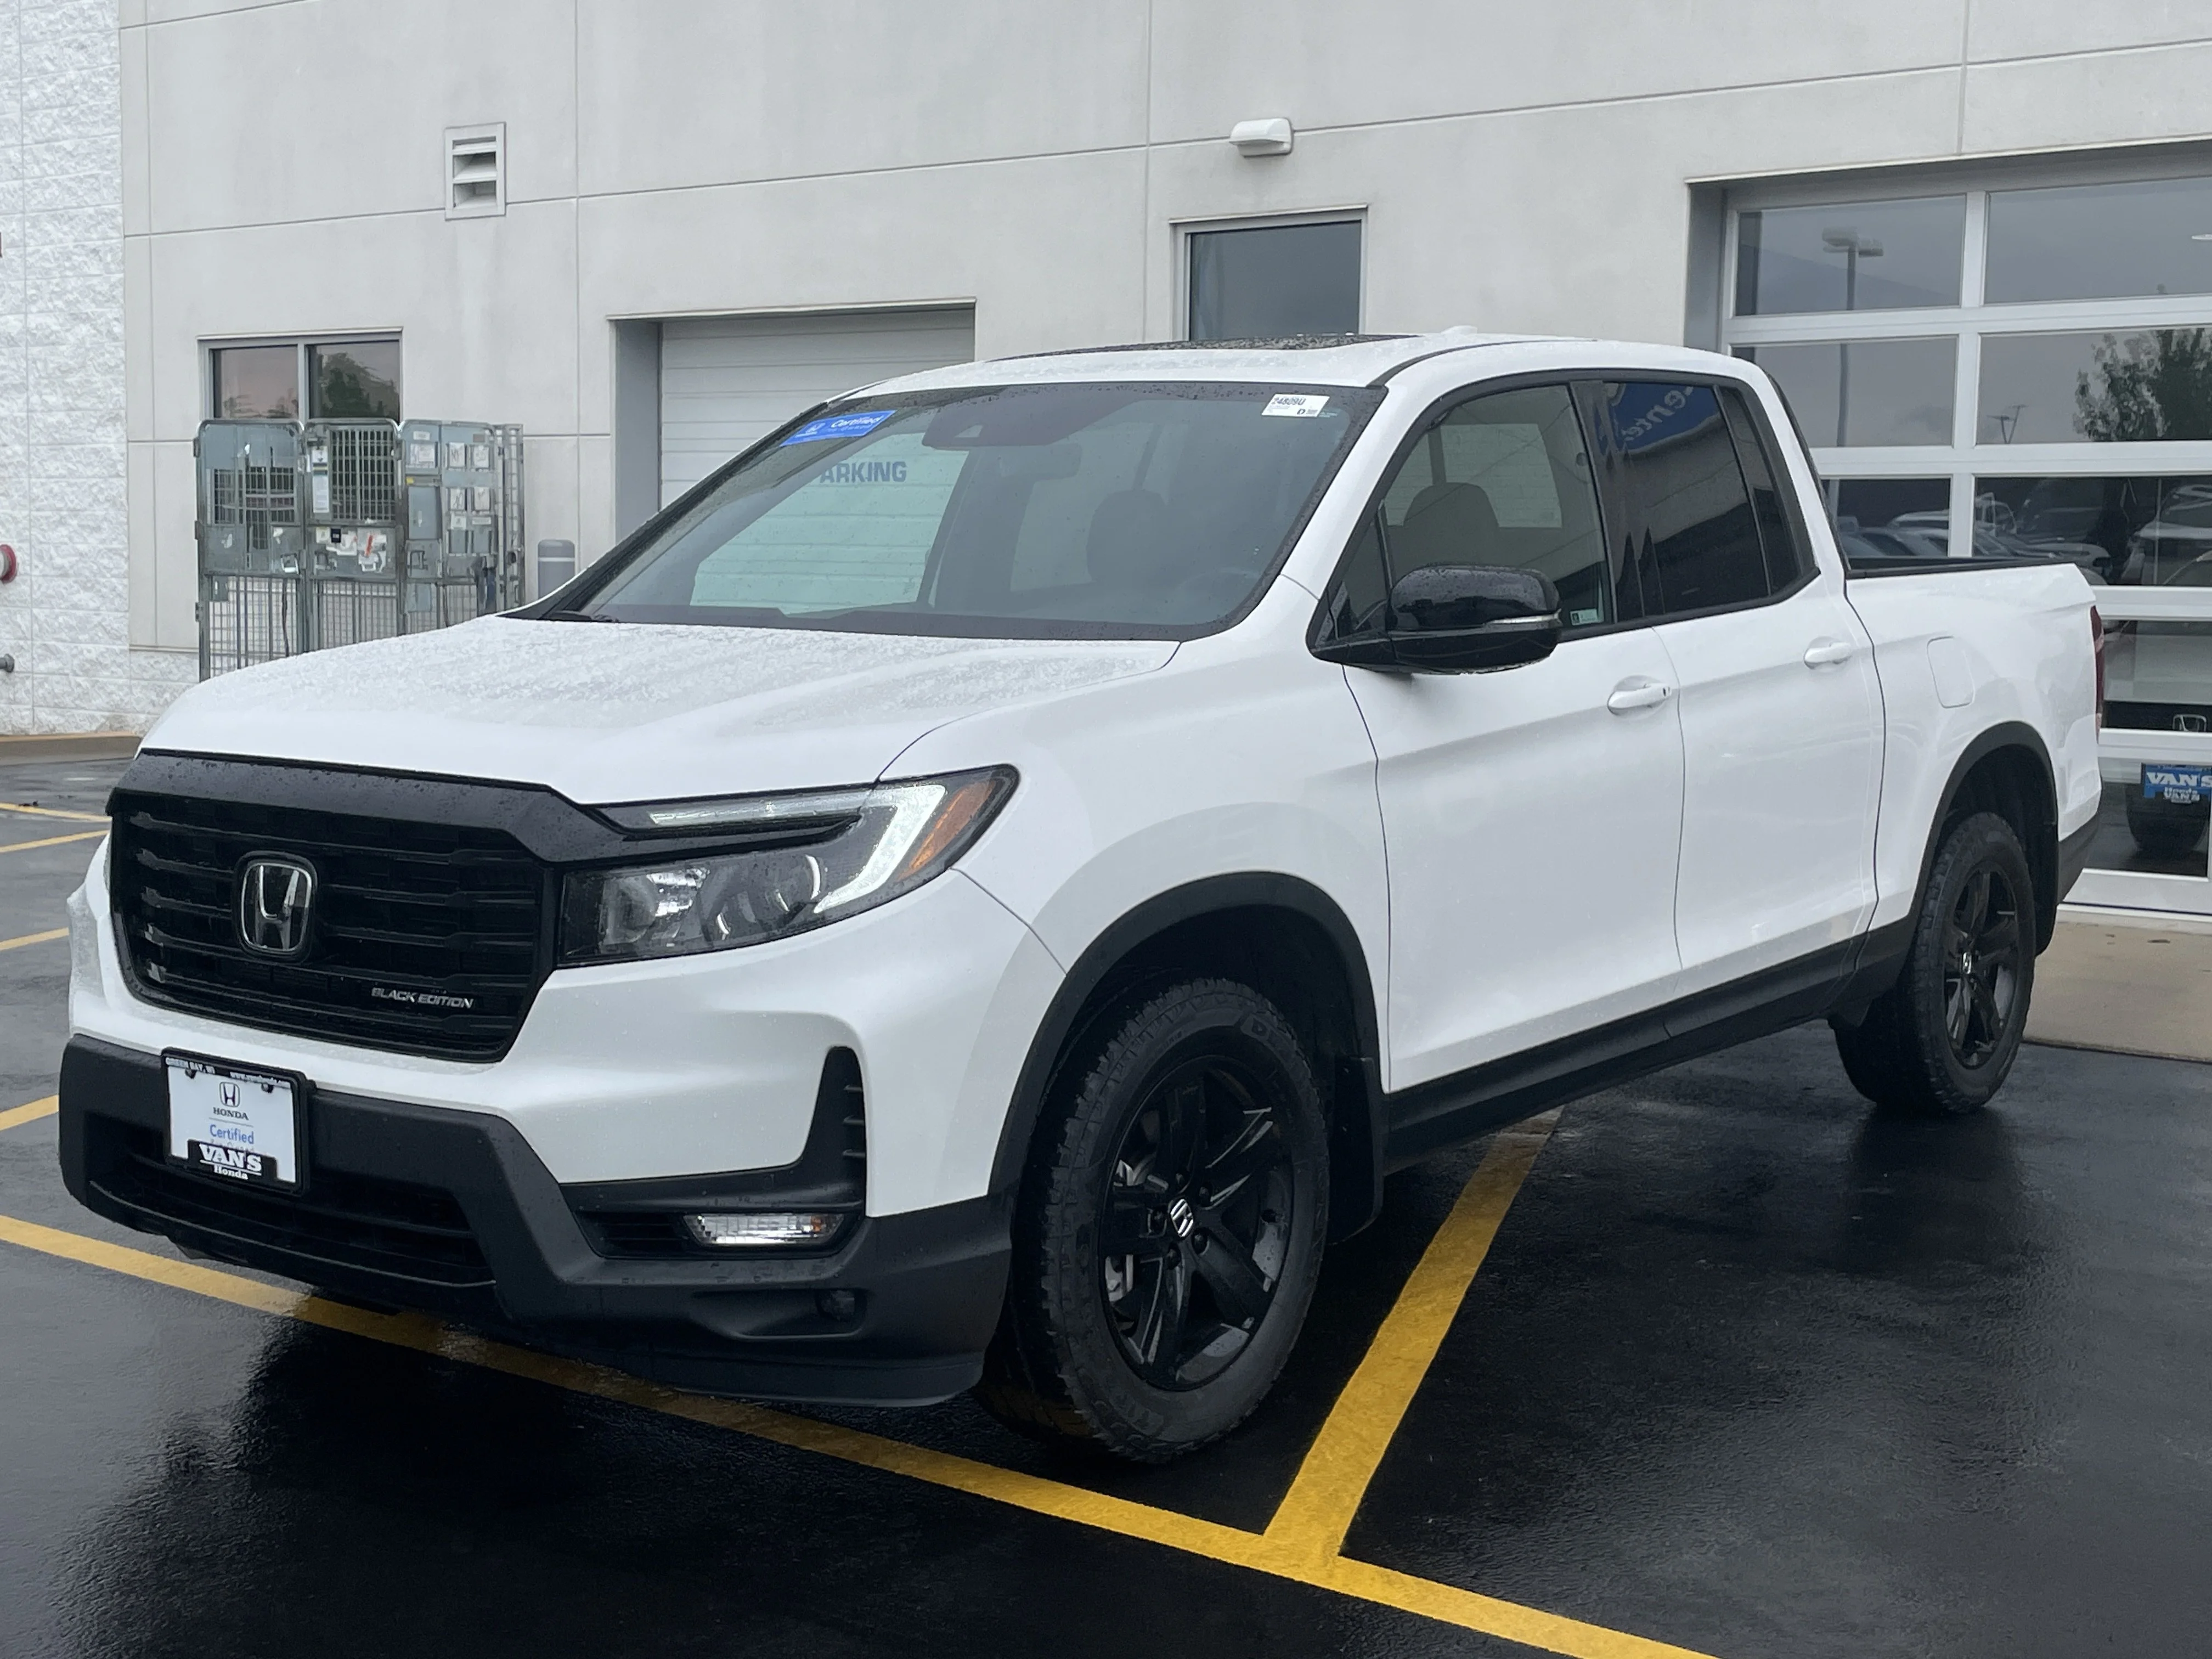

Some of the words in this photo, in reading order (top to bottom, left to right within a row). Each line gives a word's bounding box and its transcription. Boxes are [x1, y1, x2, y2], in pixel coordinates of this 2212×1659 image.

[820, 461, 906, 483] ARKING
[371, 987, 418, 1003] BLACK
[417, 992, 474, 1009] EDITION
[212, 1107, 249, 1120] HONDA
[210, 1124, 255, 1144] Certified
[213, 1165, 249, 1180] Honda
